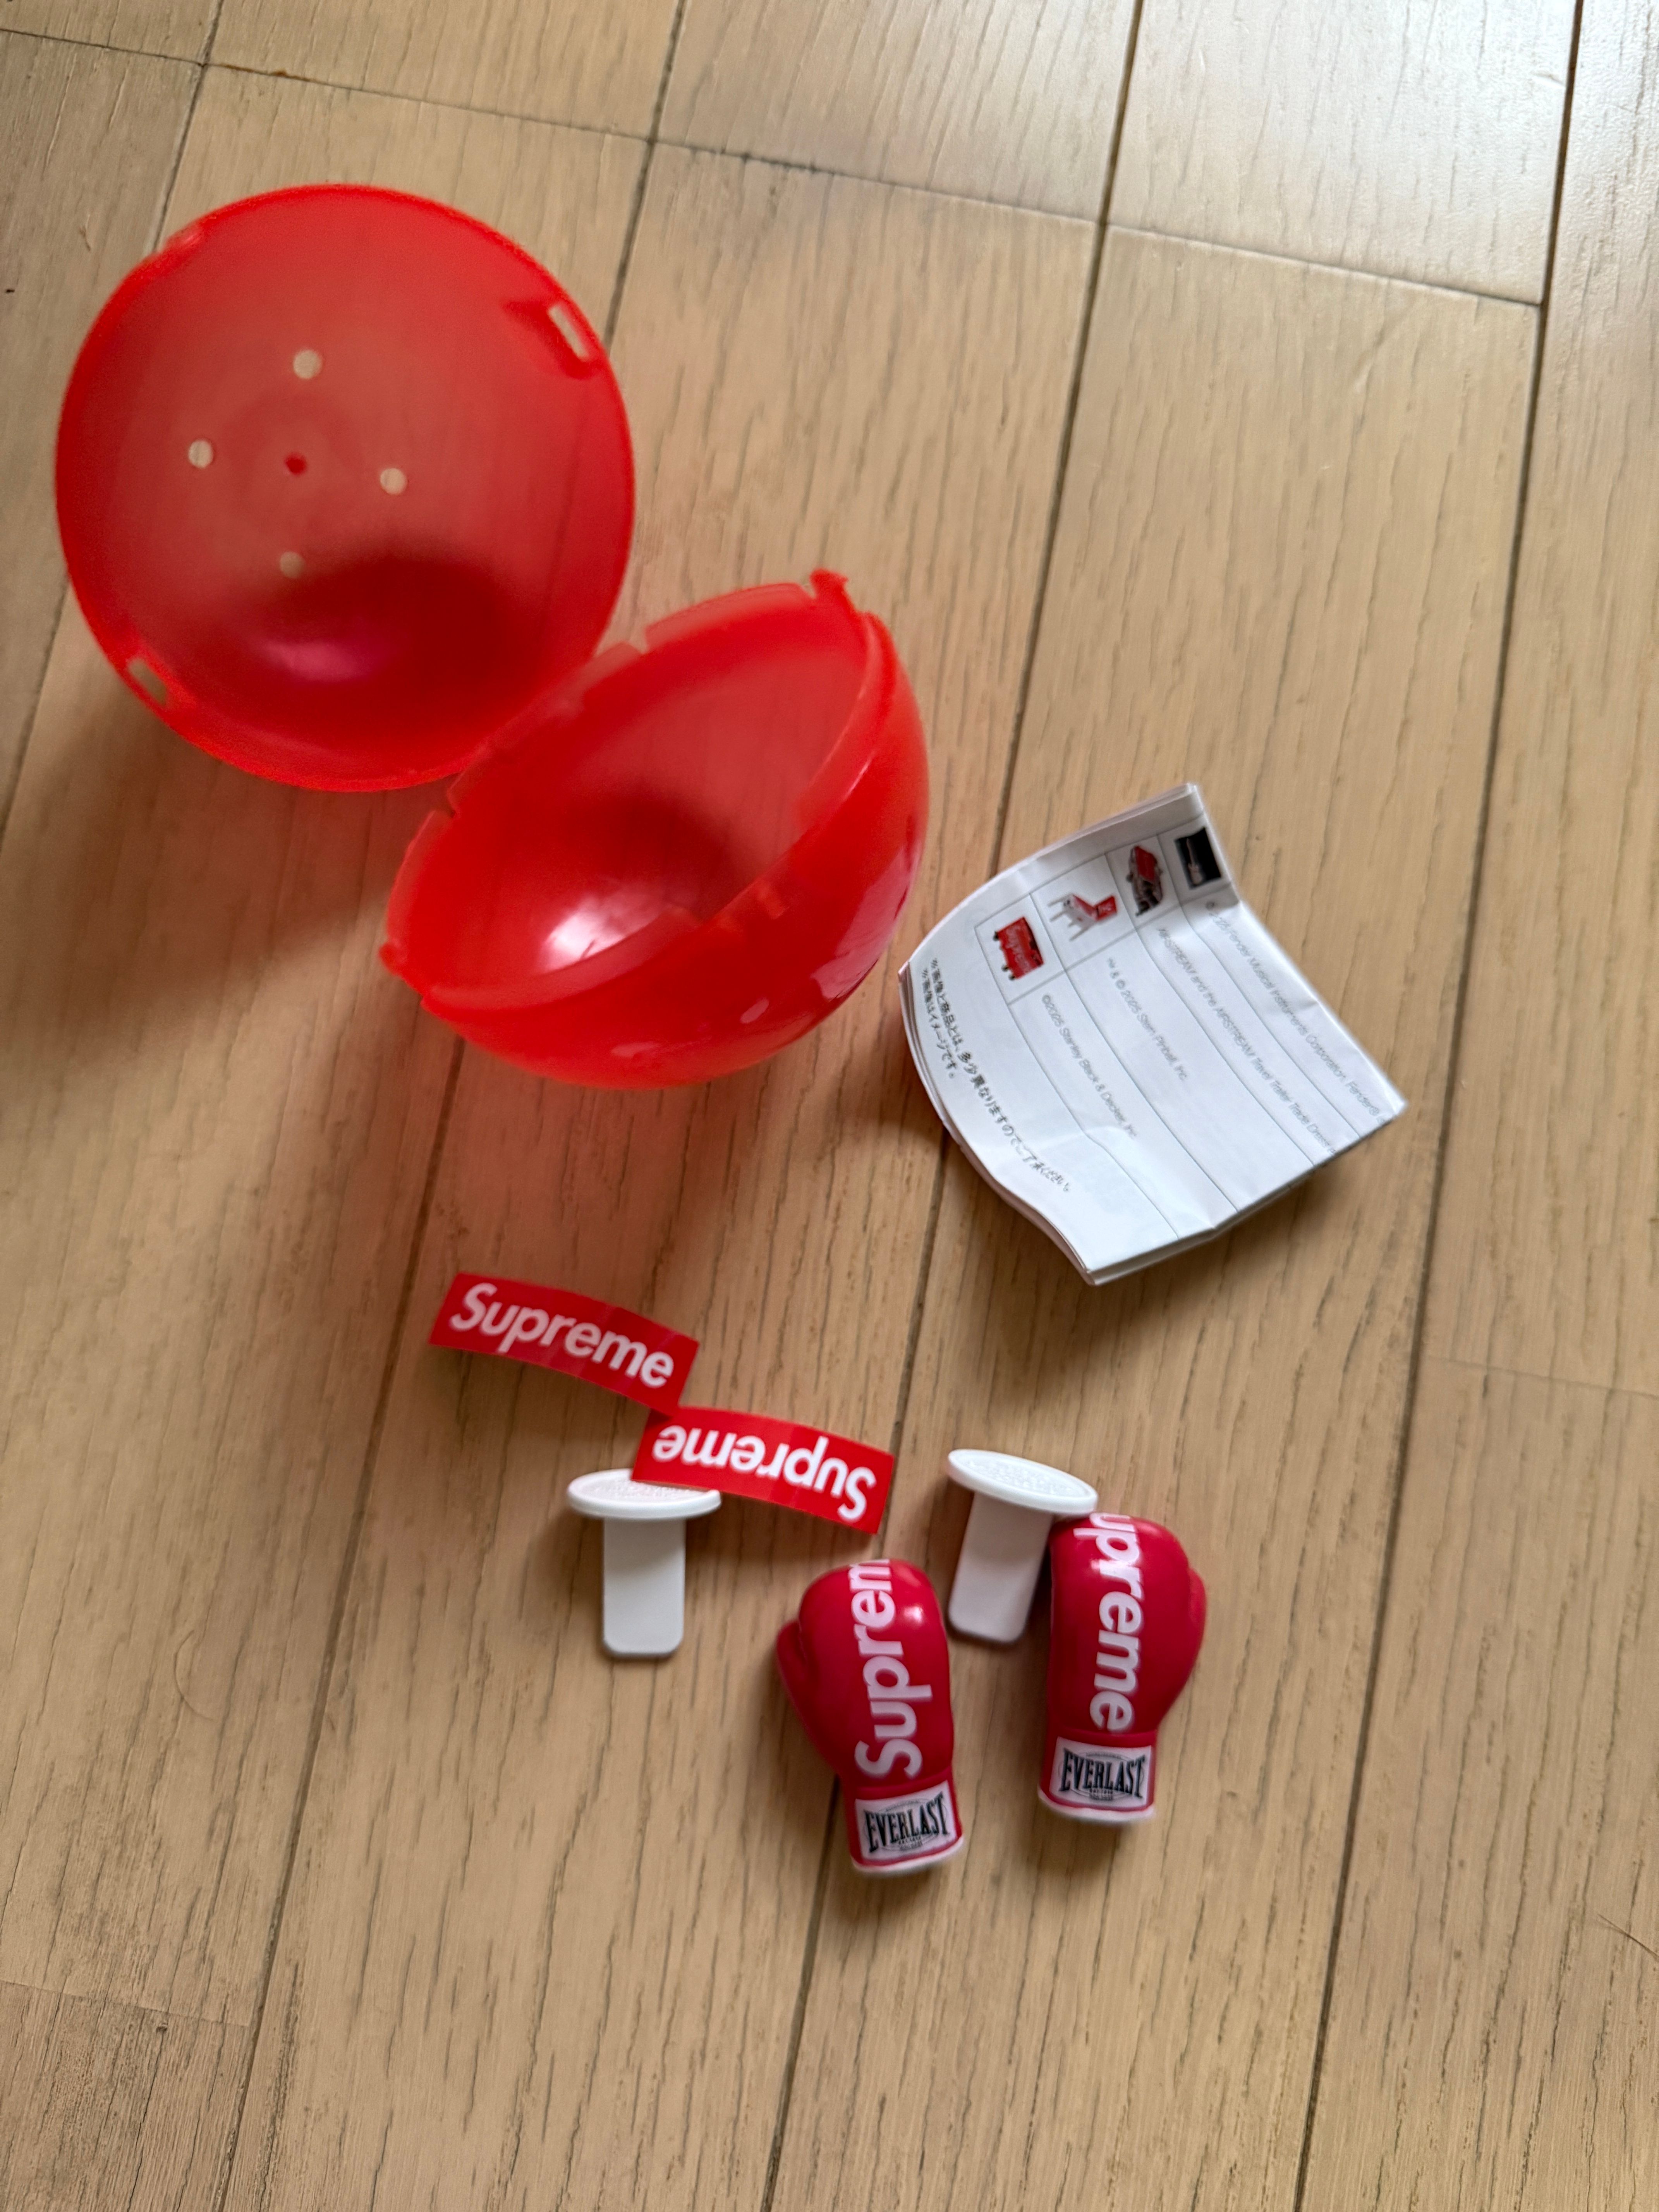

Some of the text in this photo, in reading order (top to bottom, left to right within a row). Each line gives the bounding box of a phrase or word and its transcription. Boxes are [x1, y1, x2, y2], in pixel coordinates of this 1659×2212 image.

[1191, 976, 1209, 992] and
[1203, 993, 1216, 1006] the
[1213, 1008, 1255, 1057] AIRSTREAM
[1307, 1124, 1330, 1147] Dress
[450, 1282, 675, 1388] Supreme
[652, 1425, 877, 1523] Supreme
[864, 1791, 950, 1853] EVERLAST
[1059, 1748, 1145, 1798] EVERLAST
